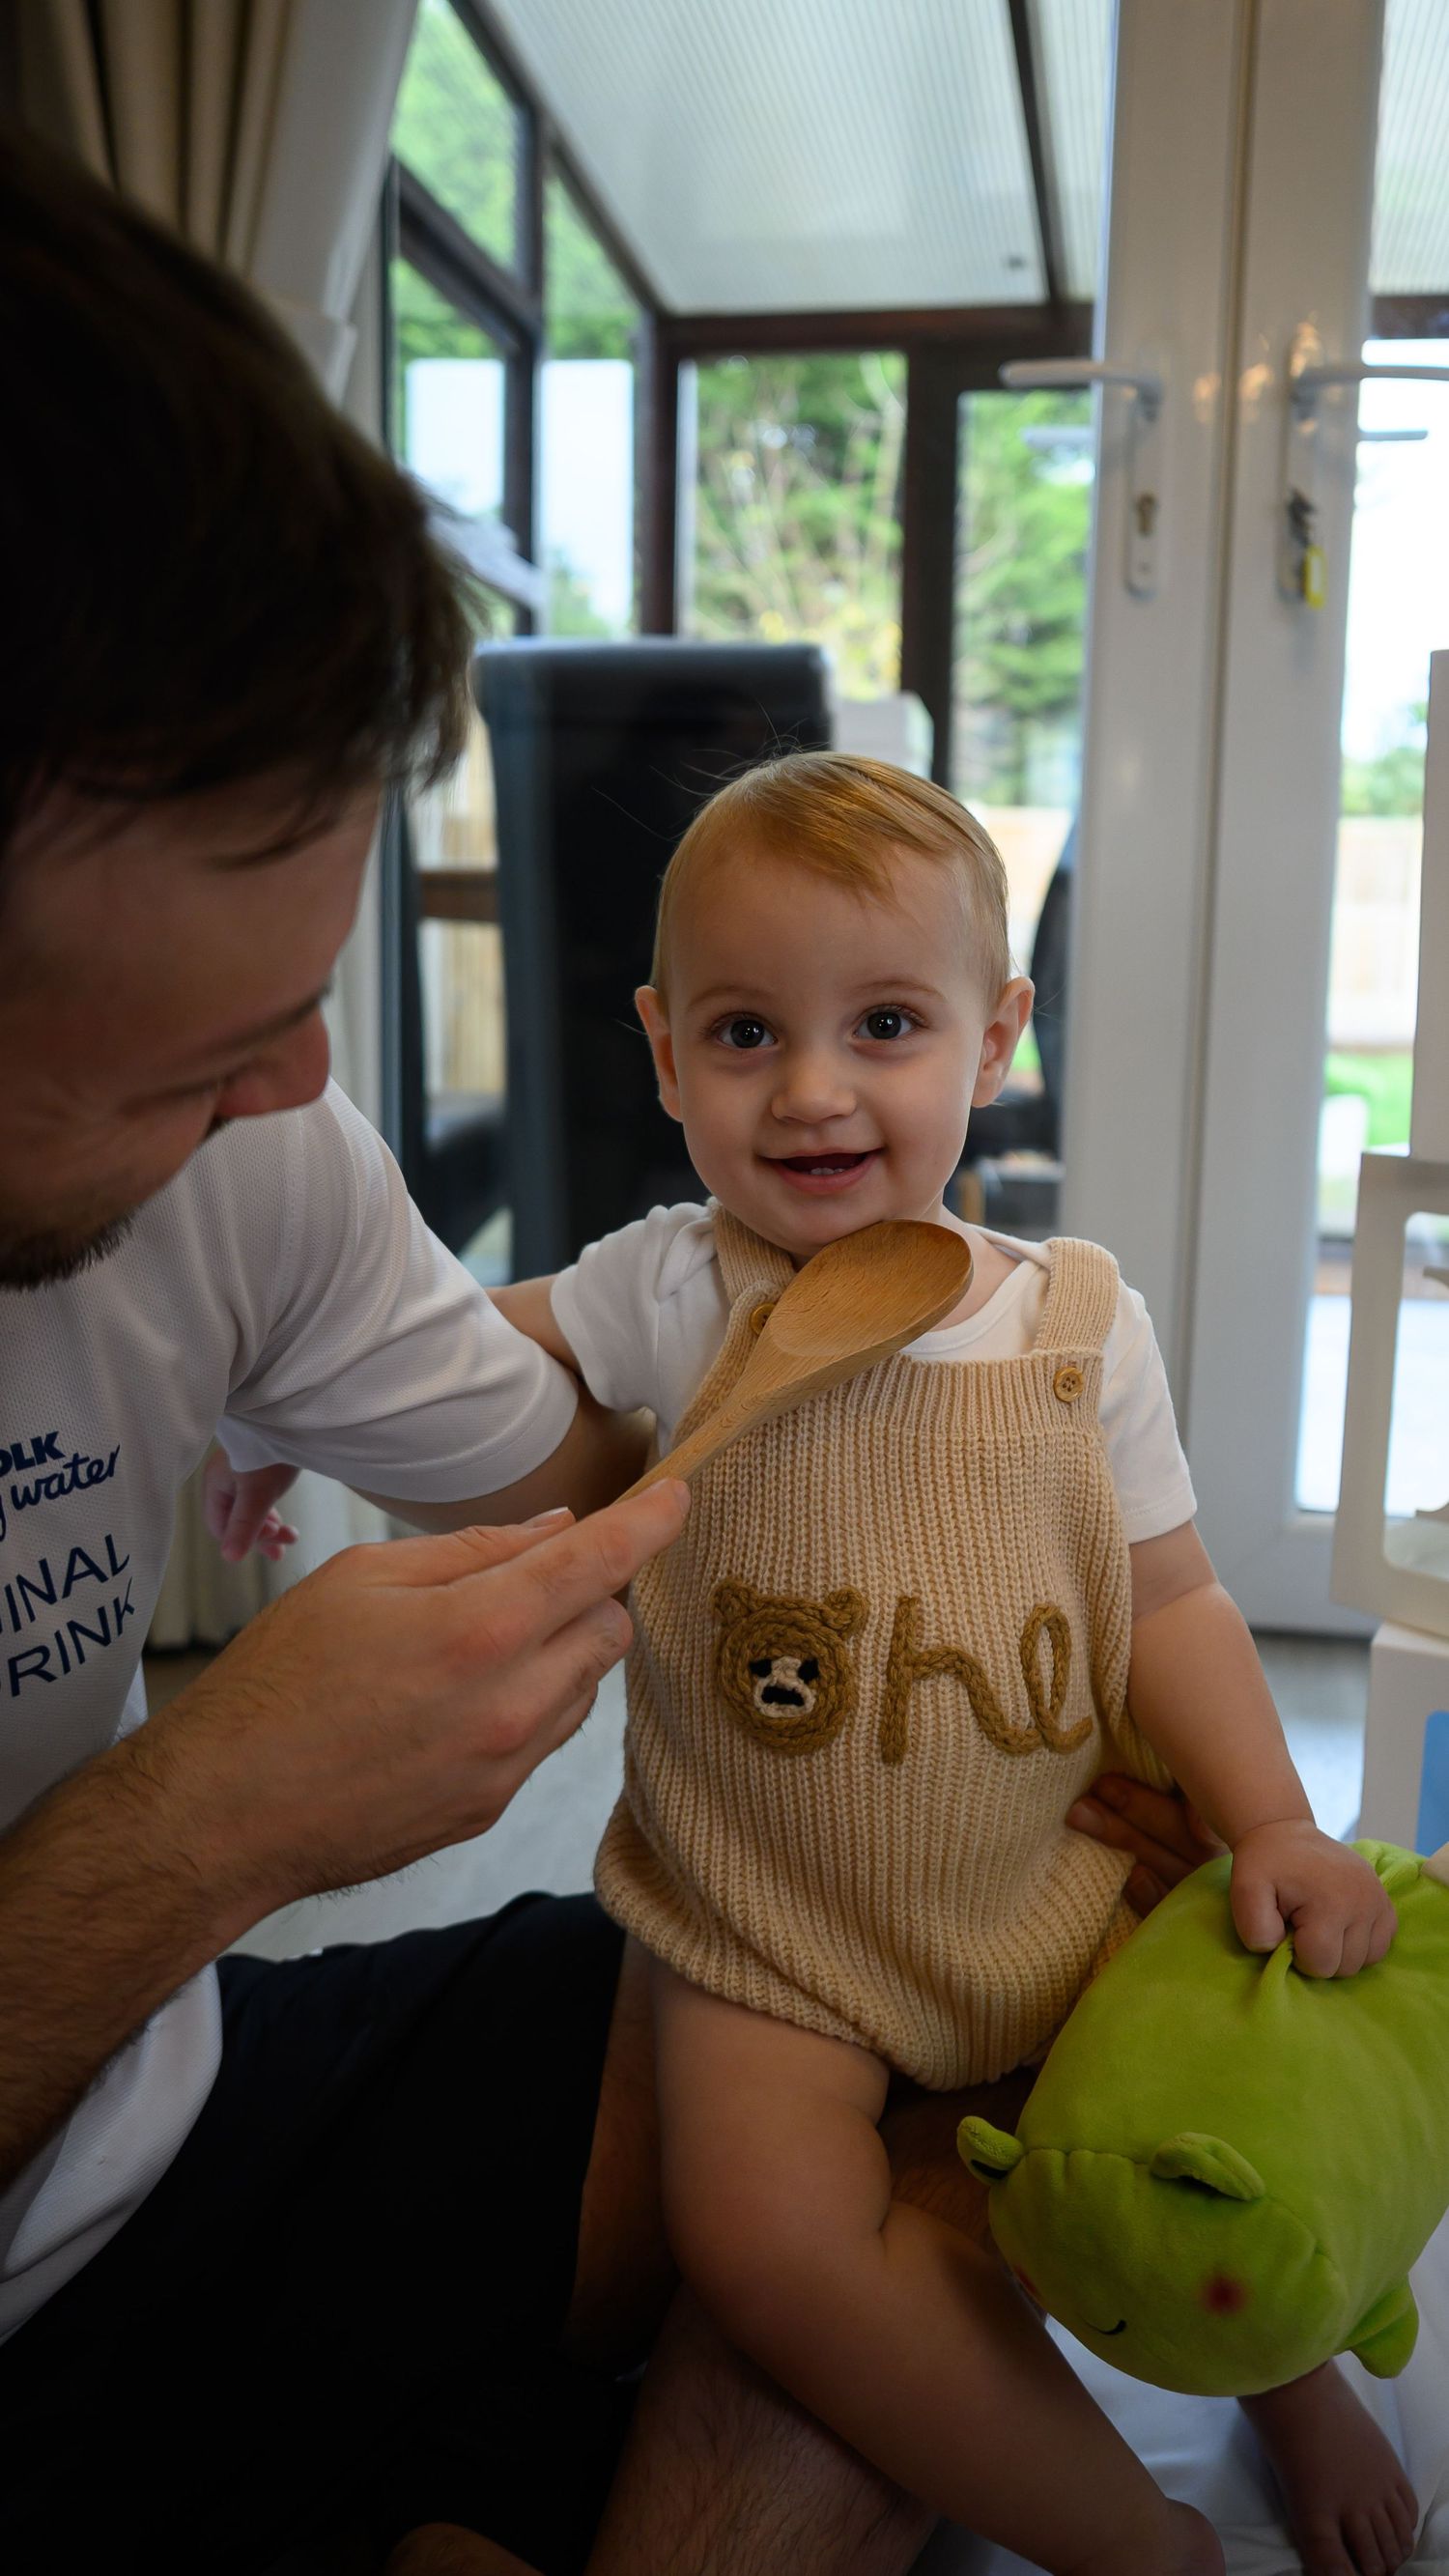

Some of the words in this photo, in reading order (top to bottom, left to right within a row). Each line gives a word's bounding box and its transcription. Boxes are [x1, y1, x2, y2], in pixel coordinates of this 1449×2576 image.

[11, 1445, 121, 1511] water
[0, 1534, 130, 1634] INAL
[0, 1575, 135, 1698] RINK
